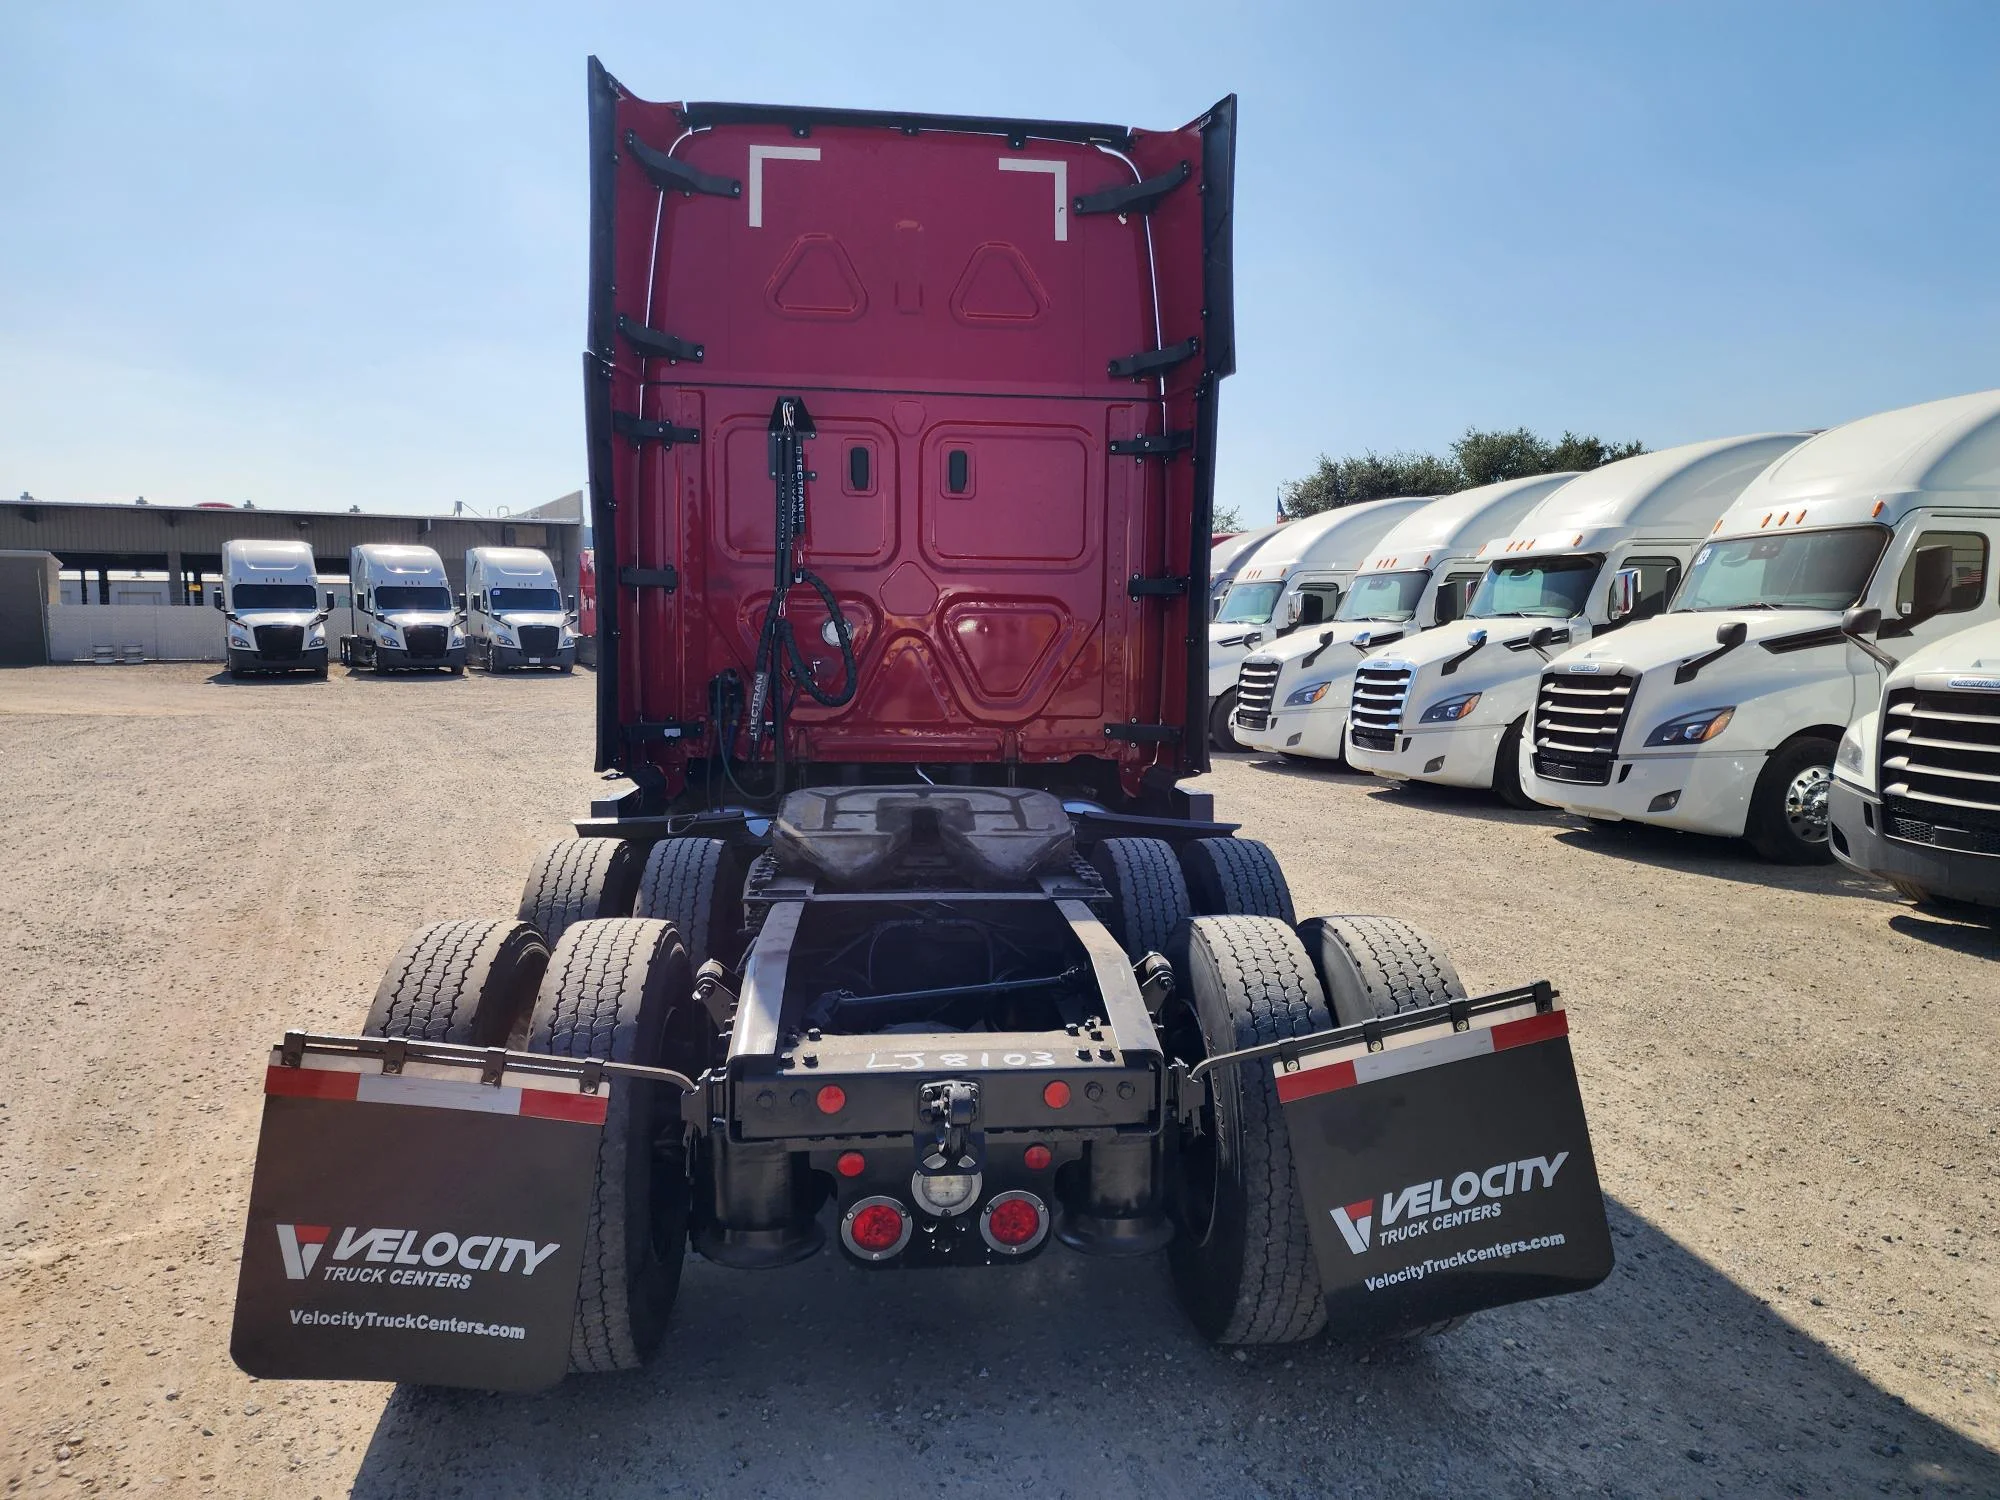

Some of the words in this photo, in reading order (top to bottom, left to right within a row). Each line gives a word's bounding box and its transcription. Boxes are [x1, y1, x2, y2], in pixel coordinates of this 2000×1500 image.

[750, 674, 763, 730] TECTRAN
[1381, 1151, 1569, 1226] VELOCITY
[1379, 1220, 1428, 1246] TRUCK
[1432, 1202, 1502, 1231] CENTERS
[333, 1227, 561, 1276] VELOCITY
[1364, 1232, 1566, 1292] VelocityTruckCenters.com
[324, 1266, 387, 1284] TRUCK
[389, 1270, 472, 1290] CENTERS
[290, 1309, 526, 1340] VelocityTruckCenters.com
